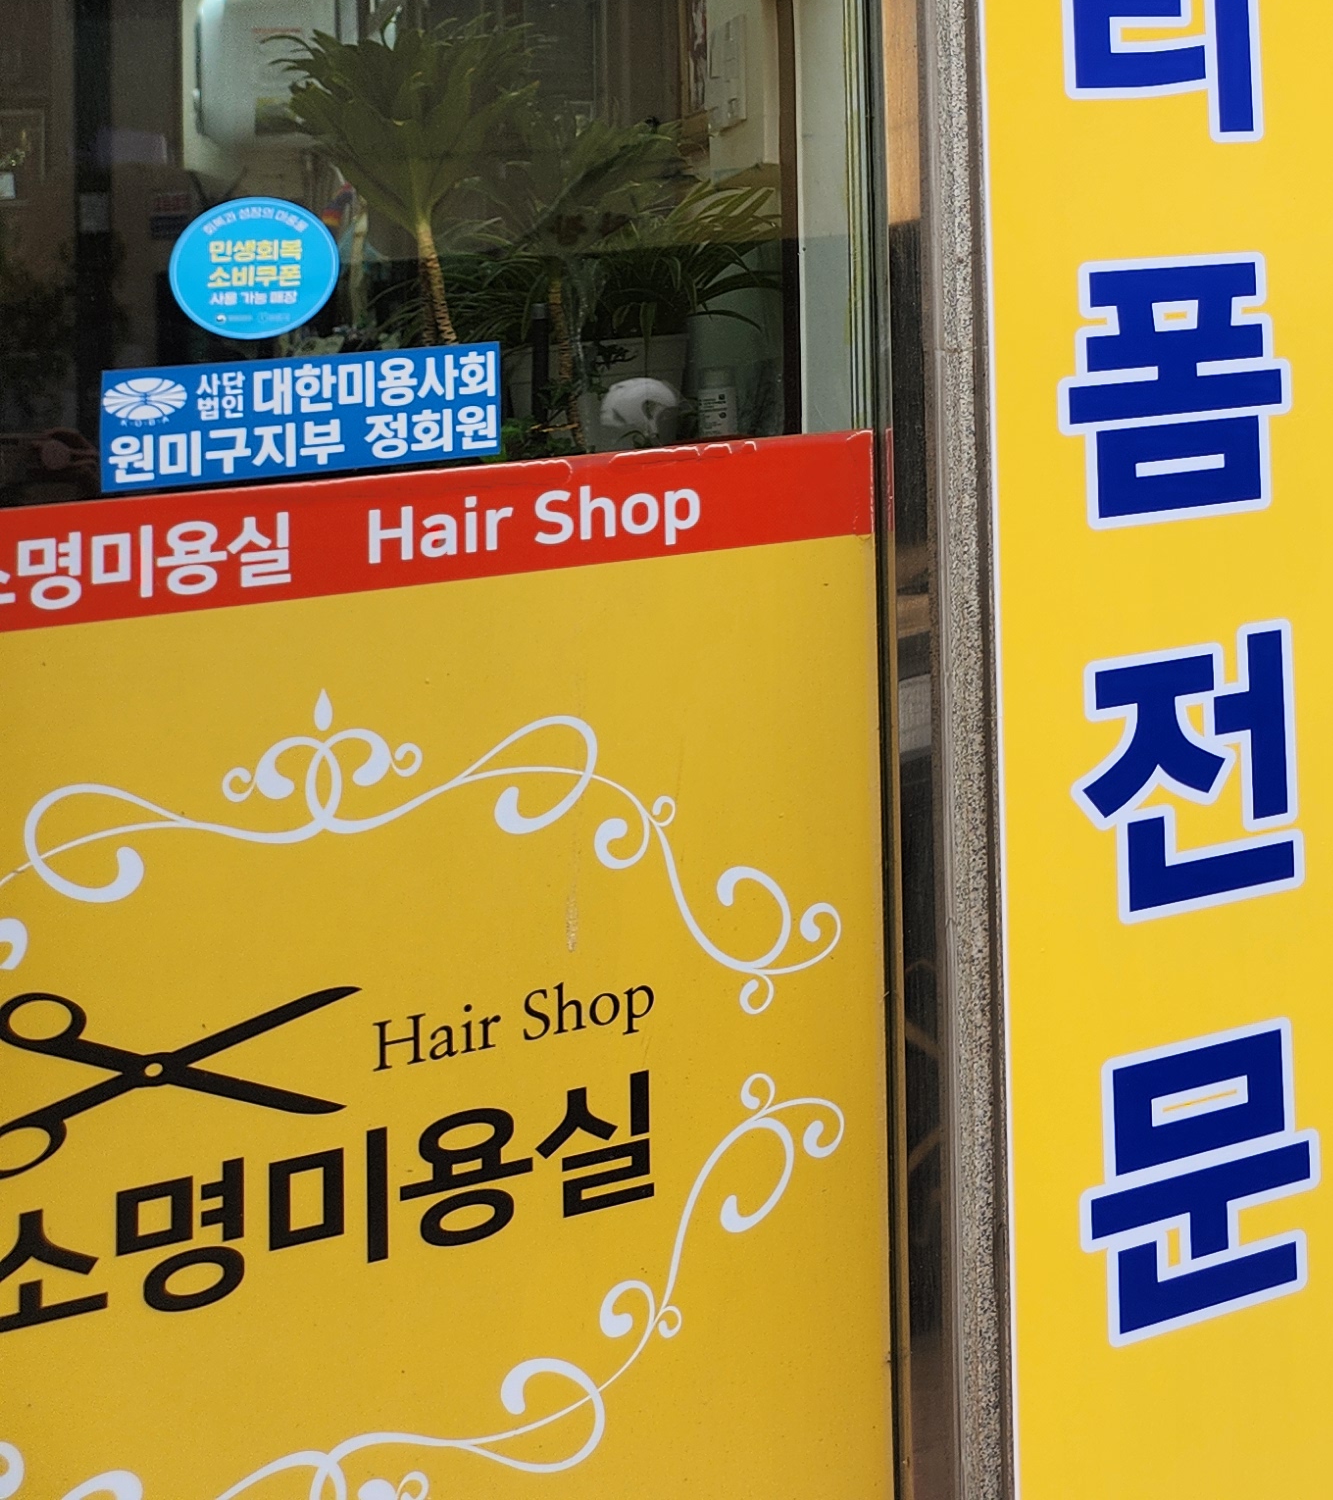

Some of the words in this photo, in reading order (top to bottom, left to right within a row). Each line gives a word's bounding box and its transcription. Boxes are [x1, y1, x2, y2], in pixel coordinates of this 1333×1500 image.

[207, 264, 301, 288] 소비쿠폰
[209, 238, 302, 263] 민생회복
[197, 370, 245, 397] 사단
[197, 395, 244, 421] 법인
[253, 350, 496, 416] 대한미용사회
[108, 418, 345, 485] 원미구지부
[364, 404, 498, 460] 정회원
[0, 510, 292, 611] 명미용실
[368, 496, 512, 565] Hair
[534, 486, 701, 546] Shop
[373, 1003, 502, 1072] Hair
[522, 982, 656, 1042] Shop
[0, 1069, 656, 1333] 소명미용실
